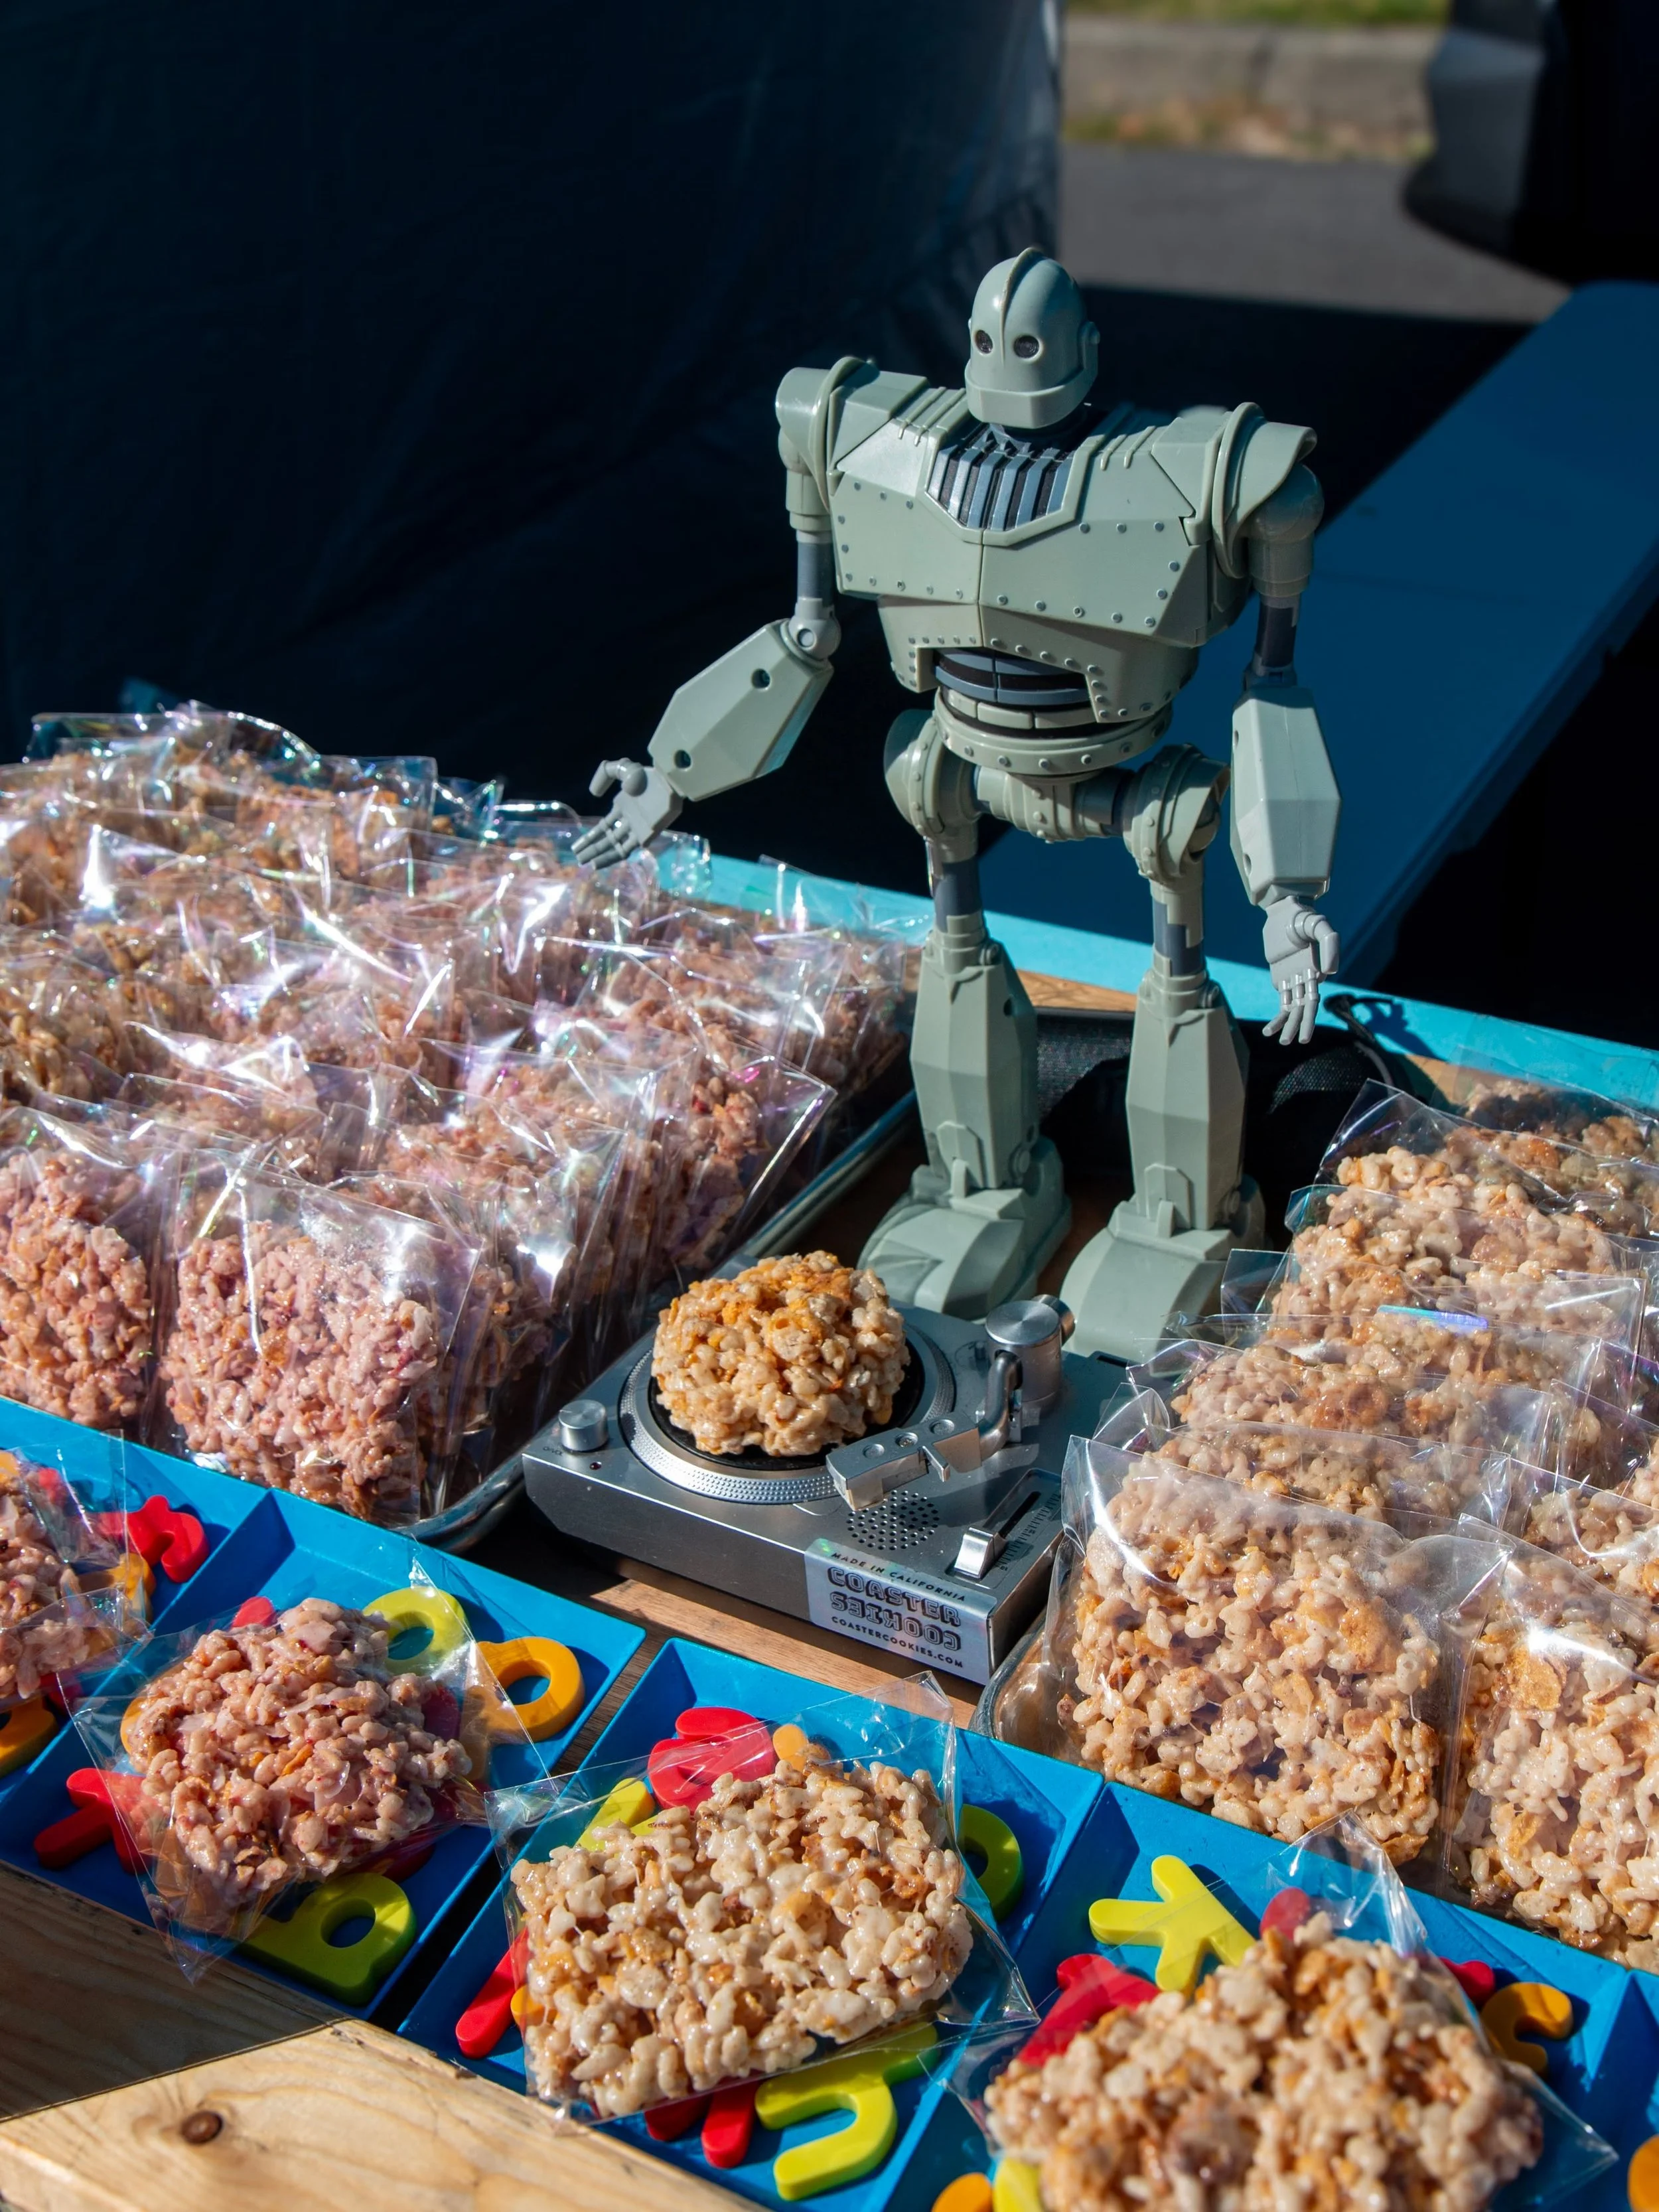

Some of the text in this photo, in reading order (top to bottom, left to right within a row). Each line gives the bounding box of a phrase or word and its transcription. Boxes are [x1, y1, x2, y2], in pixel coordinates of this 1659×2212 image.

[828, 1566, 961, 1627] COASTER
[831, 1552, 866, 1567] MADE
[889, 1572, 965, 1601] CALIFORNIA
[830, 1591, 962, 1651] COOKIES
[831, 1616, 963, 1668] COASTERCOOKIES.COM
